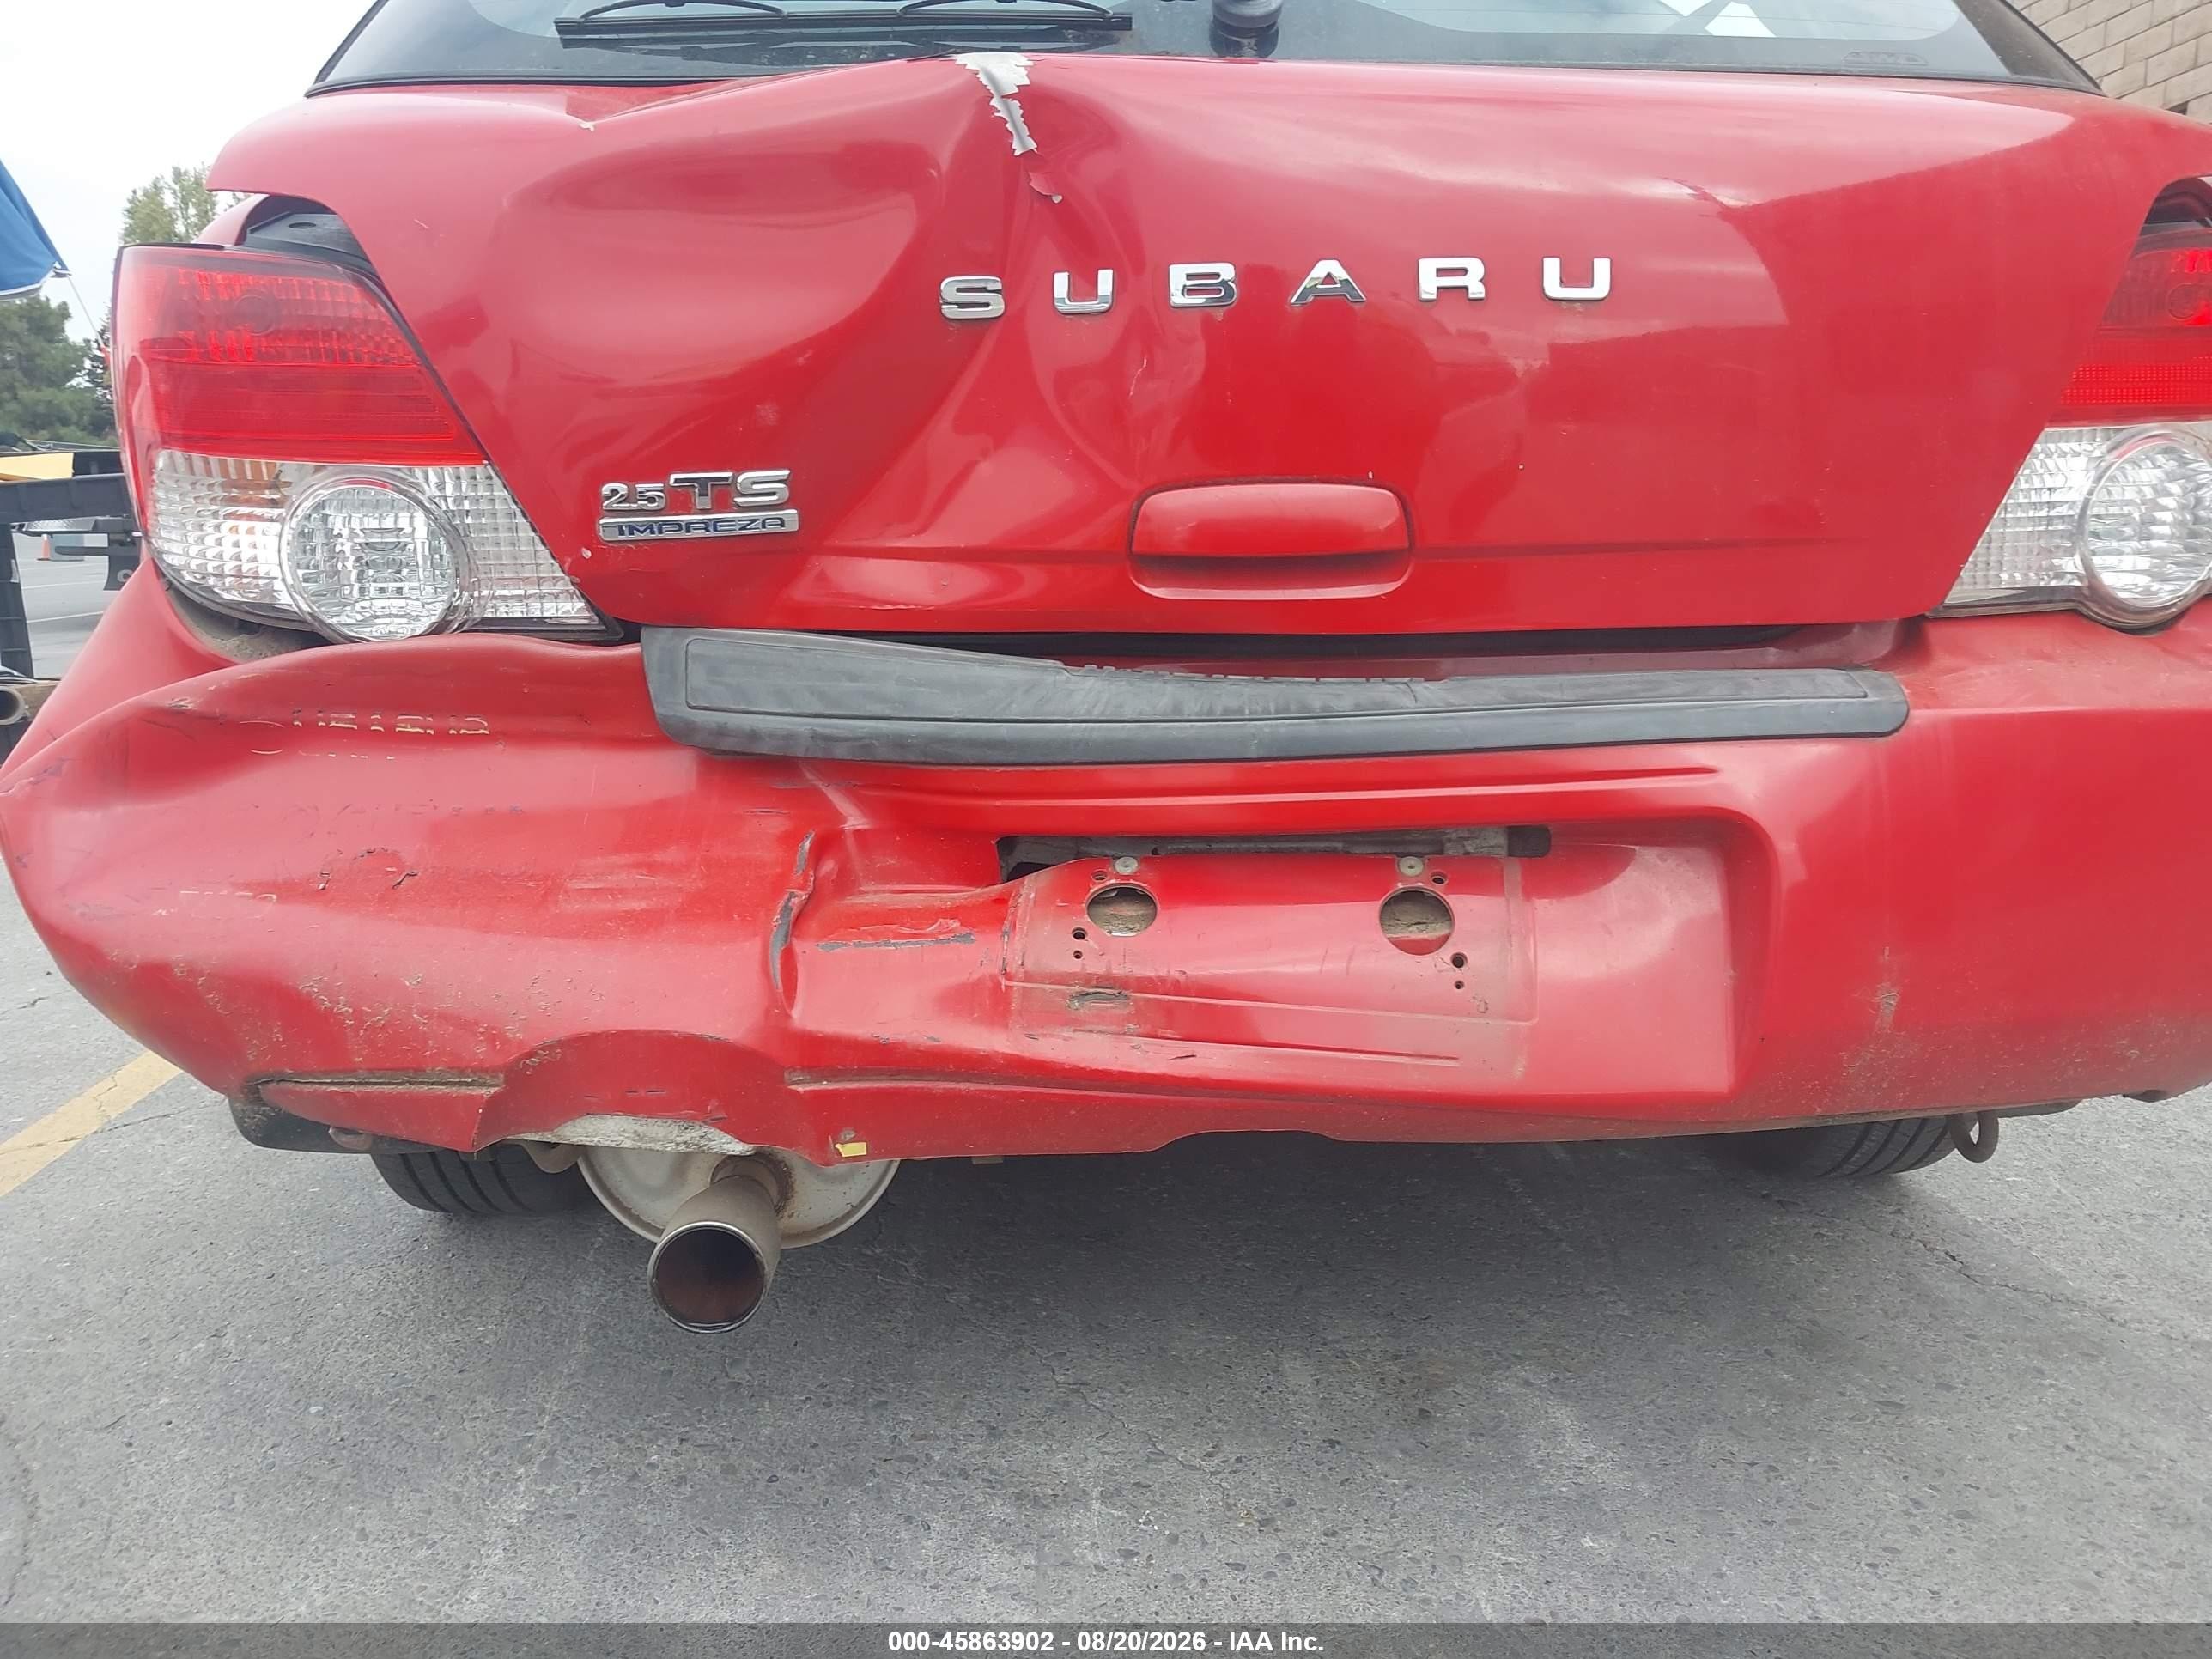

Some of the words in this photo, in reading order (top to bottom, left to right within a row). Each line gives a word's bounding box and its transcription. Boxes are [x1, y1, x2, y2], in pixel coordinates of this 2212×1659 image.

[939, 257, 1613, 320] SUBARU
[669, 469, 792, 510] TS
[617, 517, 786, 538] IMPREZA
